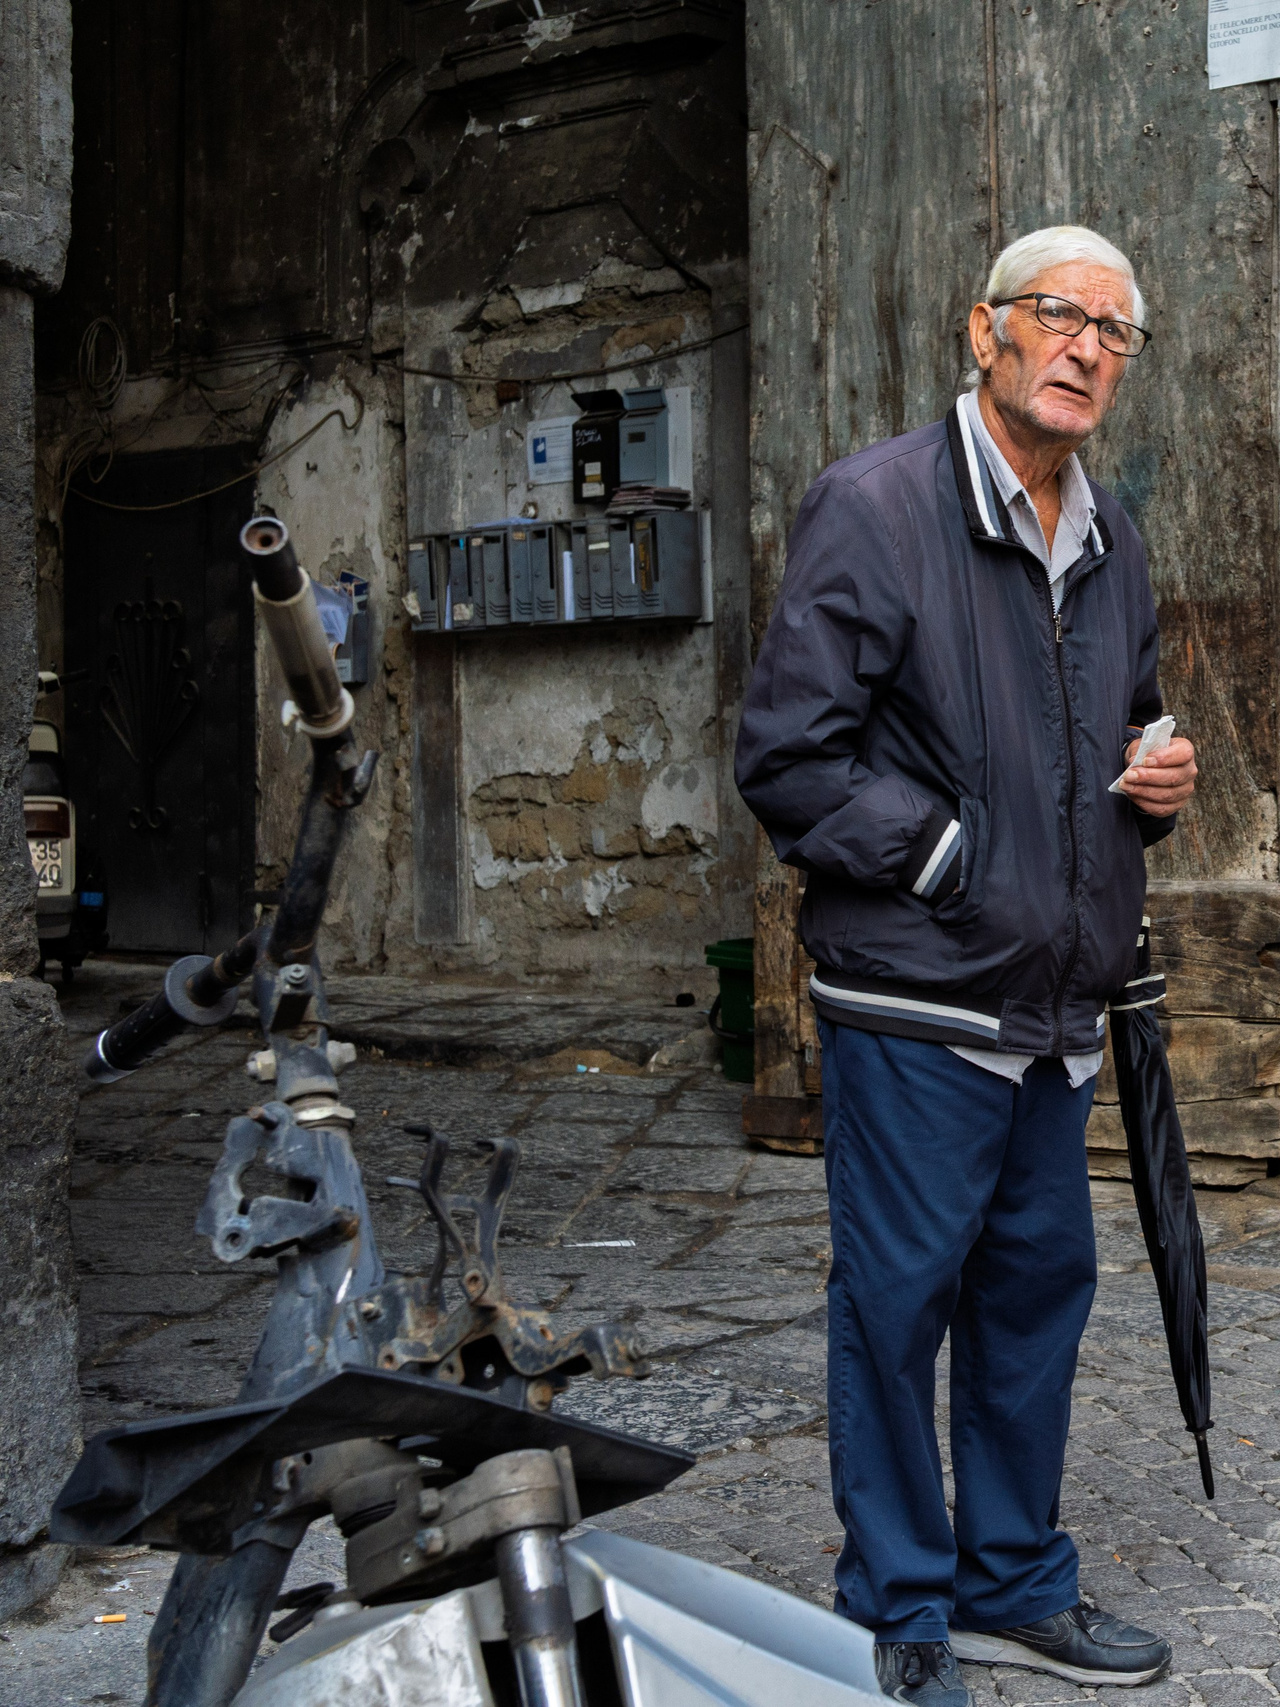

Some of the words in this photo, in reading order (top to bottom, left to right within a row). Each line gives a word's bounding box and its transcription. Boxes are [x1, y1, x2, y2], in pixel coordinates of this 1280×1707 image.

[1219, 16, 1264, 30] TELECAMERE
[1223, 25, 1259, 38] CANCELLO
[1209, 37, 1241, 49] CITOFONI
[36, 840, 61, 861] 35
